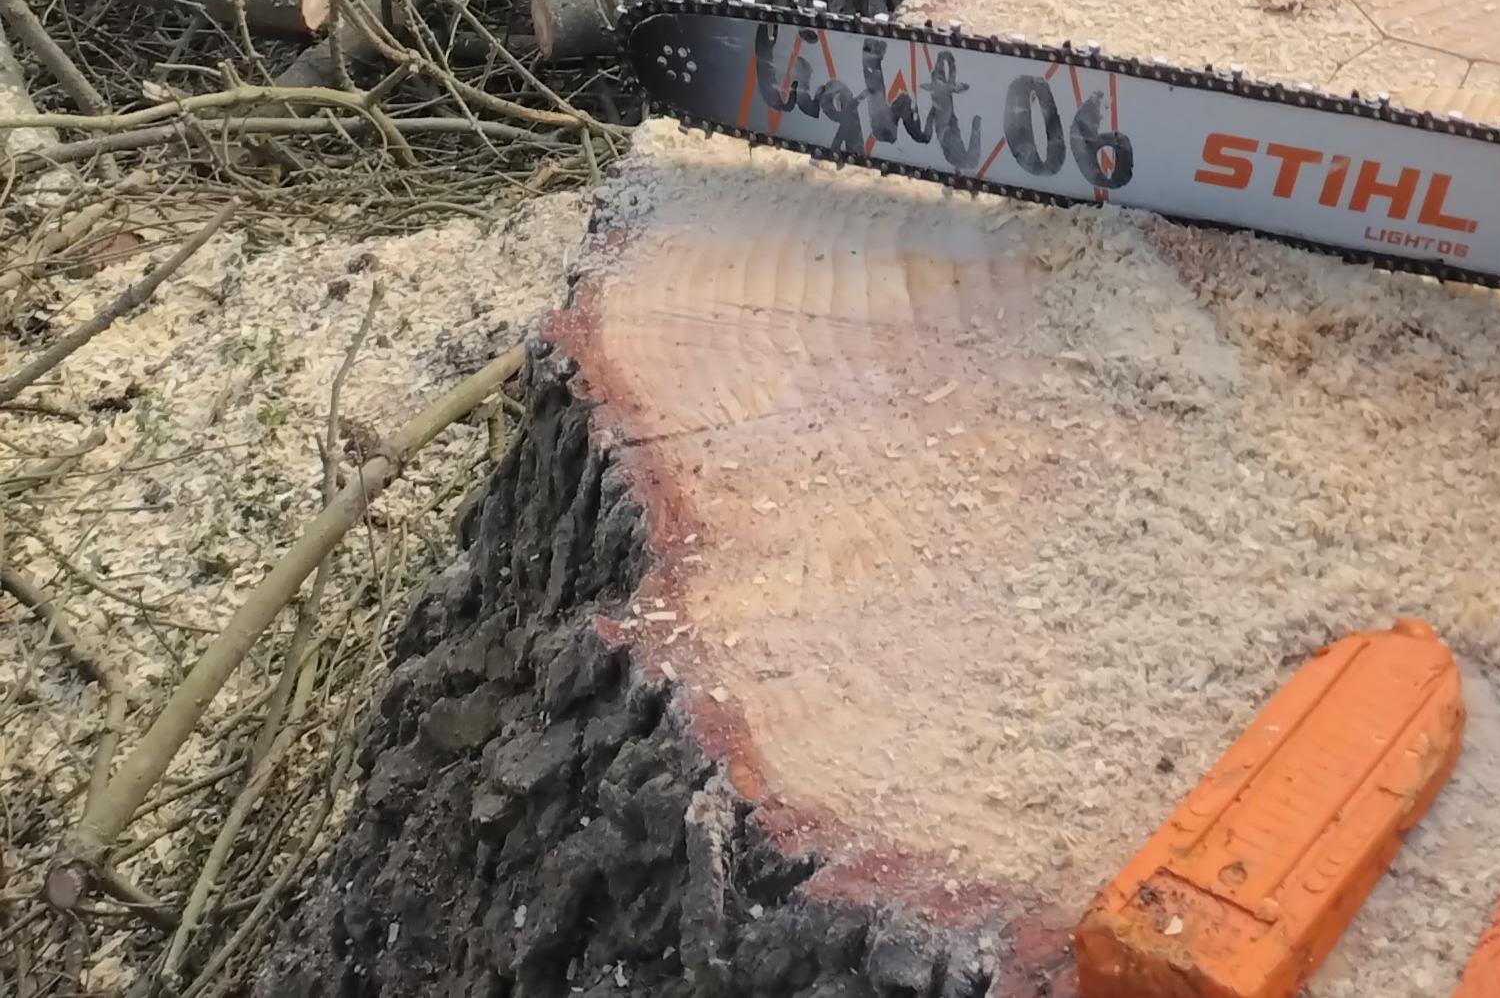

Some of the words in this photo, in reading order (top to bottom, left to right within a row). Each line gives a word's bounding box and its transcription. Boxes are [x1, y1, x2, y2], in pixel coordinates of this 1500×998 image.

[1003, 74, 1134, 189] 06
[1193, 132, 1479, 234] STIHL
[1364, 226, 1435, 250] LIGHT
